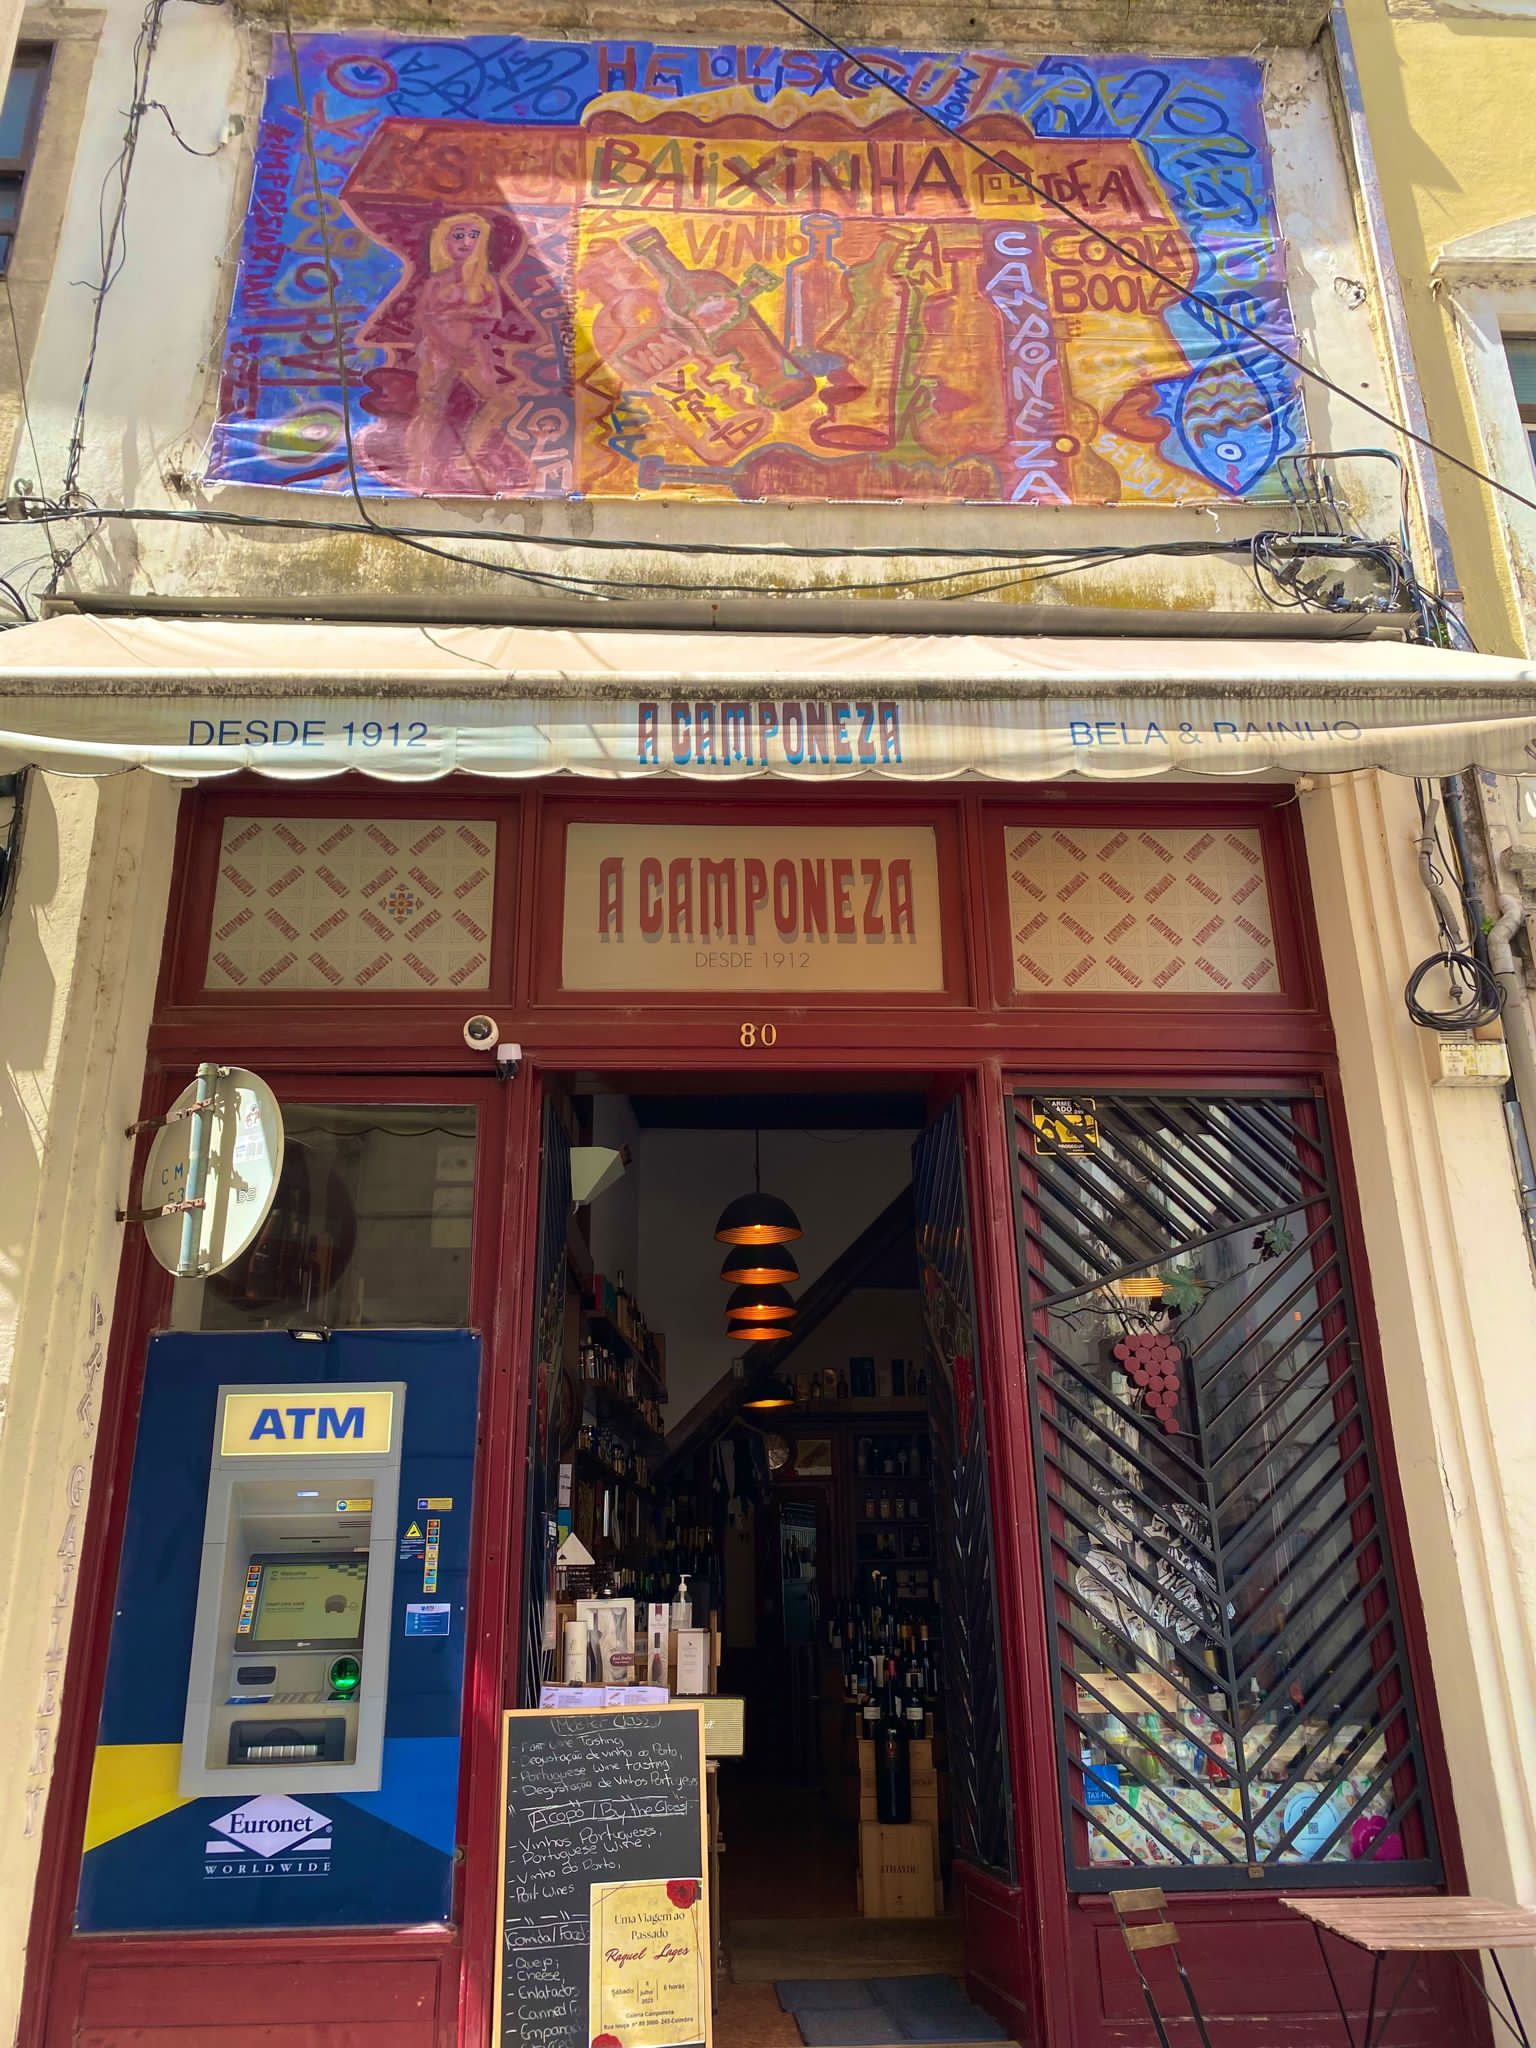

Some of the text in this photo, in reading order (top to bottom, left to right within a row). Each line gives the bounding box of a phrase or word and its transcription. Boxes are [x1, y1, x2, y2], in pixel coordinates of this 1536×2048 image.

[591, 136, 968, 217] BAIXINHA
[683, 217, 809, 270] VINHO
[985, 231, 1071, 505] CAMPONEZA
[188, 719, 428, 748] DESDE 1912
[637, 701, 904, 766] A CAMPONEZA
[1069, 720, 1363, 746] BELA & RAINHO
[597, 857, 625, 943] A
[638, 857, 917, 945] CAMPONEZA
[694, 952, 811, 969] DESDE 1912
[739, 1022, 777, 1048] 80
[248, 1406, 366, 1441] ATM
[629, 1802, 653, 1817] the
[228, 1812, 314, 1835] Euronet
[519, 1834, 572, 1852] Vinhos
[204, 1860, 332, 1875] WORLDWIDE
[614, 1911, 685, 1925] Uma Viagem ao
[631, 1928, 669, 1940] Passado
[604, 1946, 648, 1968] Raquel
